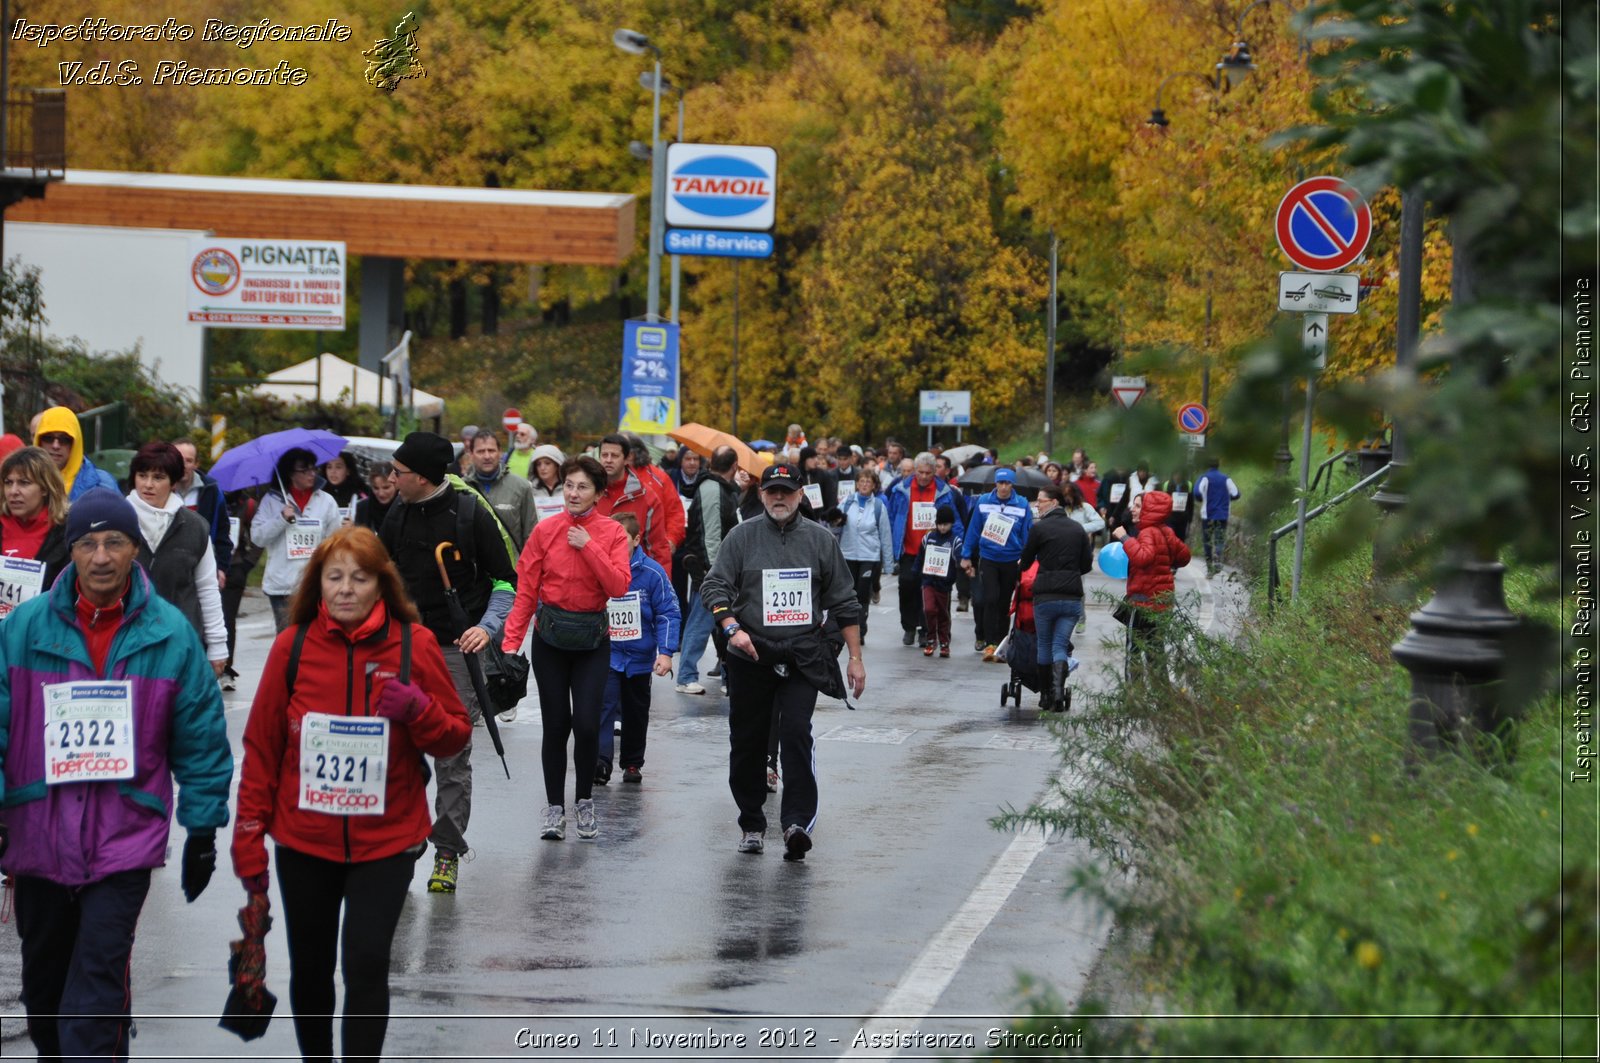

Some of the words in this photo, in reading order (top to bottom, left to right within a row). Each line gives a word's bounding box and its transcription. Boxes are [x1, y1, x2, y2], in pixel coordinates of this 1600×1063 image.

[672, 177, 770, 195] TAMOIL
[669, 233, 703, 247] Self
[706, 234, 769, 250] Service
[241, 245, 340, 265] PIGNATTA
[308, 265, 340, 275] Bruno
[633, 359, 667, 378] 2%
[293, 534, 314, 545] 5069
[772, 591, 803, 607] 2307
[611, 611, 633, 625] 1320
[767, 611, 809, 623] ipercoop
[60, 719, 115, 748] 2322
[51, 757, 128, 778] ipercoop
[316, 753, 368, 782] 2321
[305, 784, 378, 808] ipercoop
